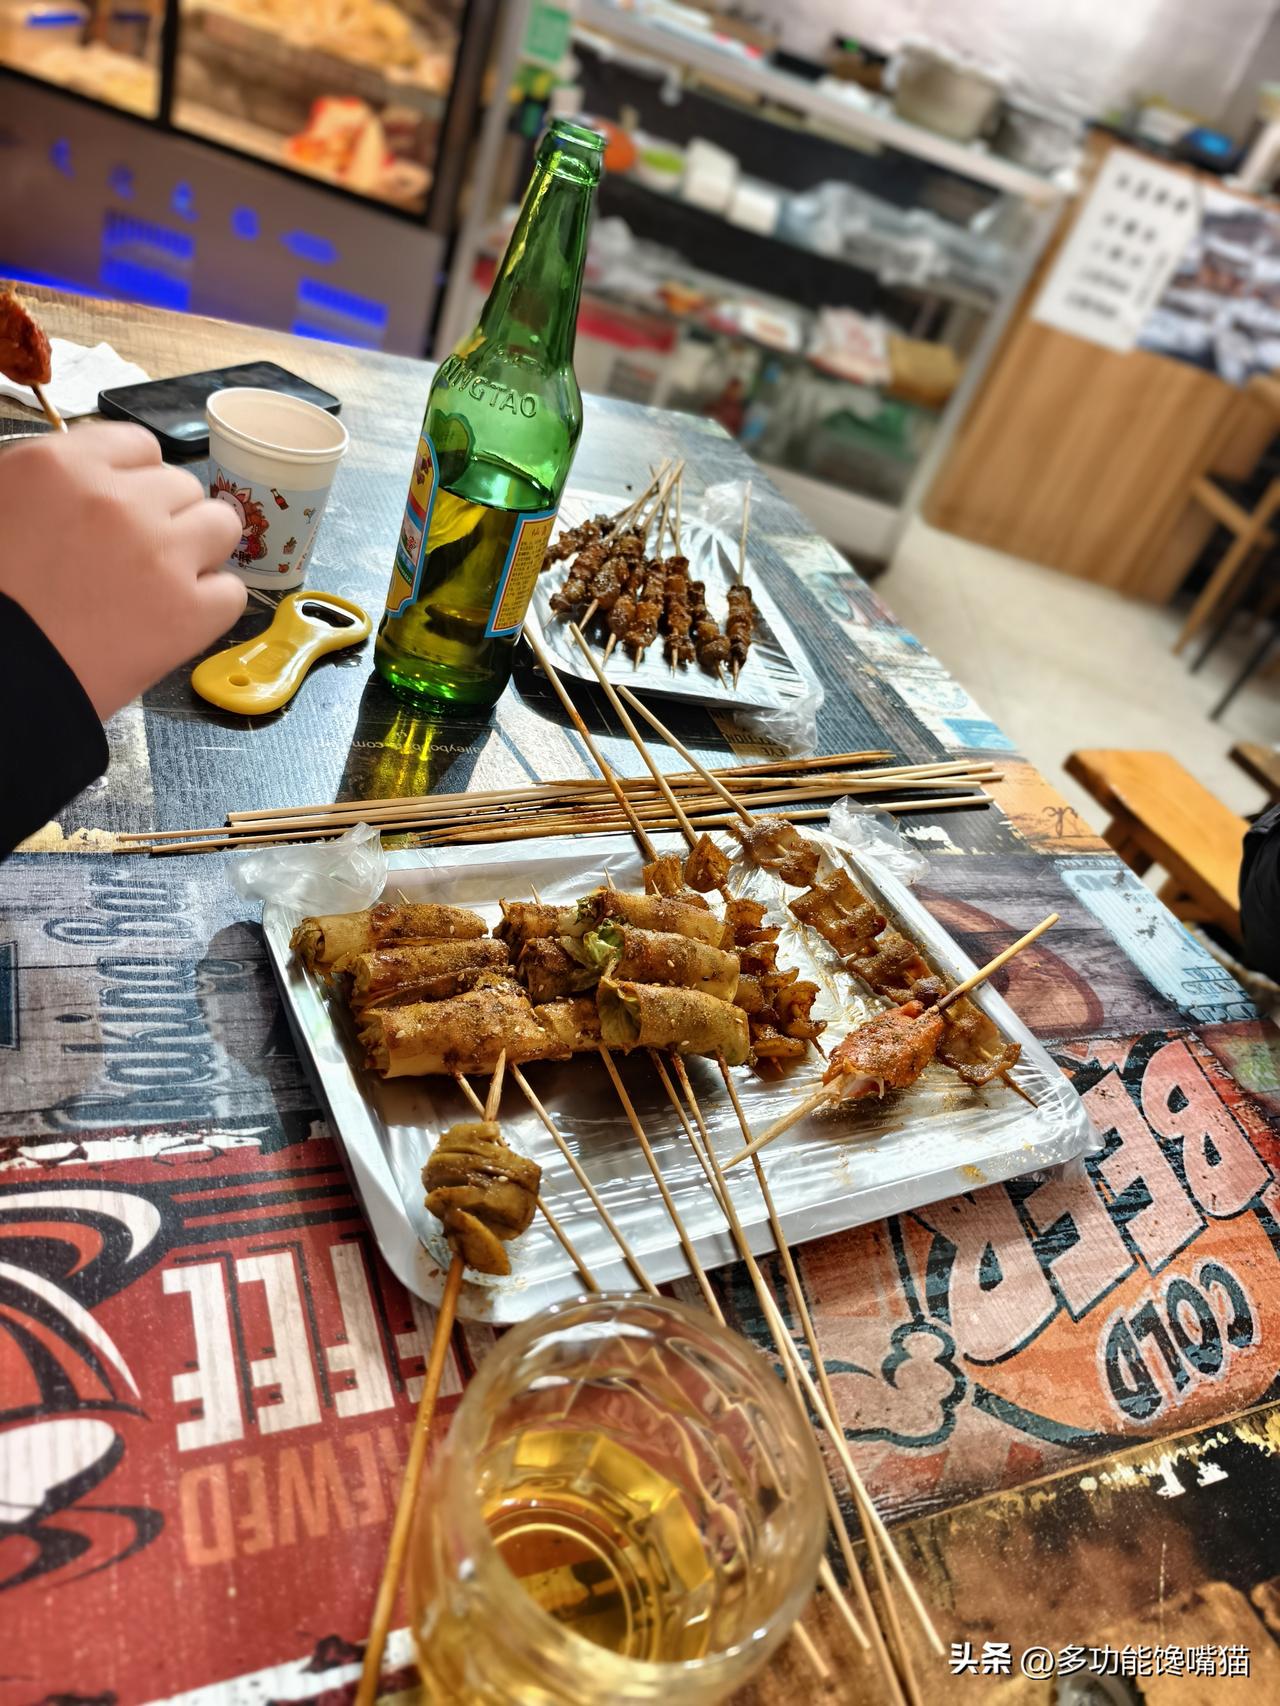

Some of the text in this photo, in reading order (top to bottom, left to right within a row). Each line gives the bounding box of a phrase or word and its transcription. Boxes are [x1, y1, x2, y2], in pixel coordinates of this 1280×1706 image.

[40, 869, 258, 1131] Baking Bar
[951, 1034, 1272, 1362] BEER
[1104, 1260, 1254, 1420] COLD
